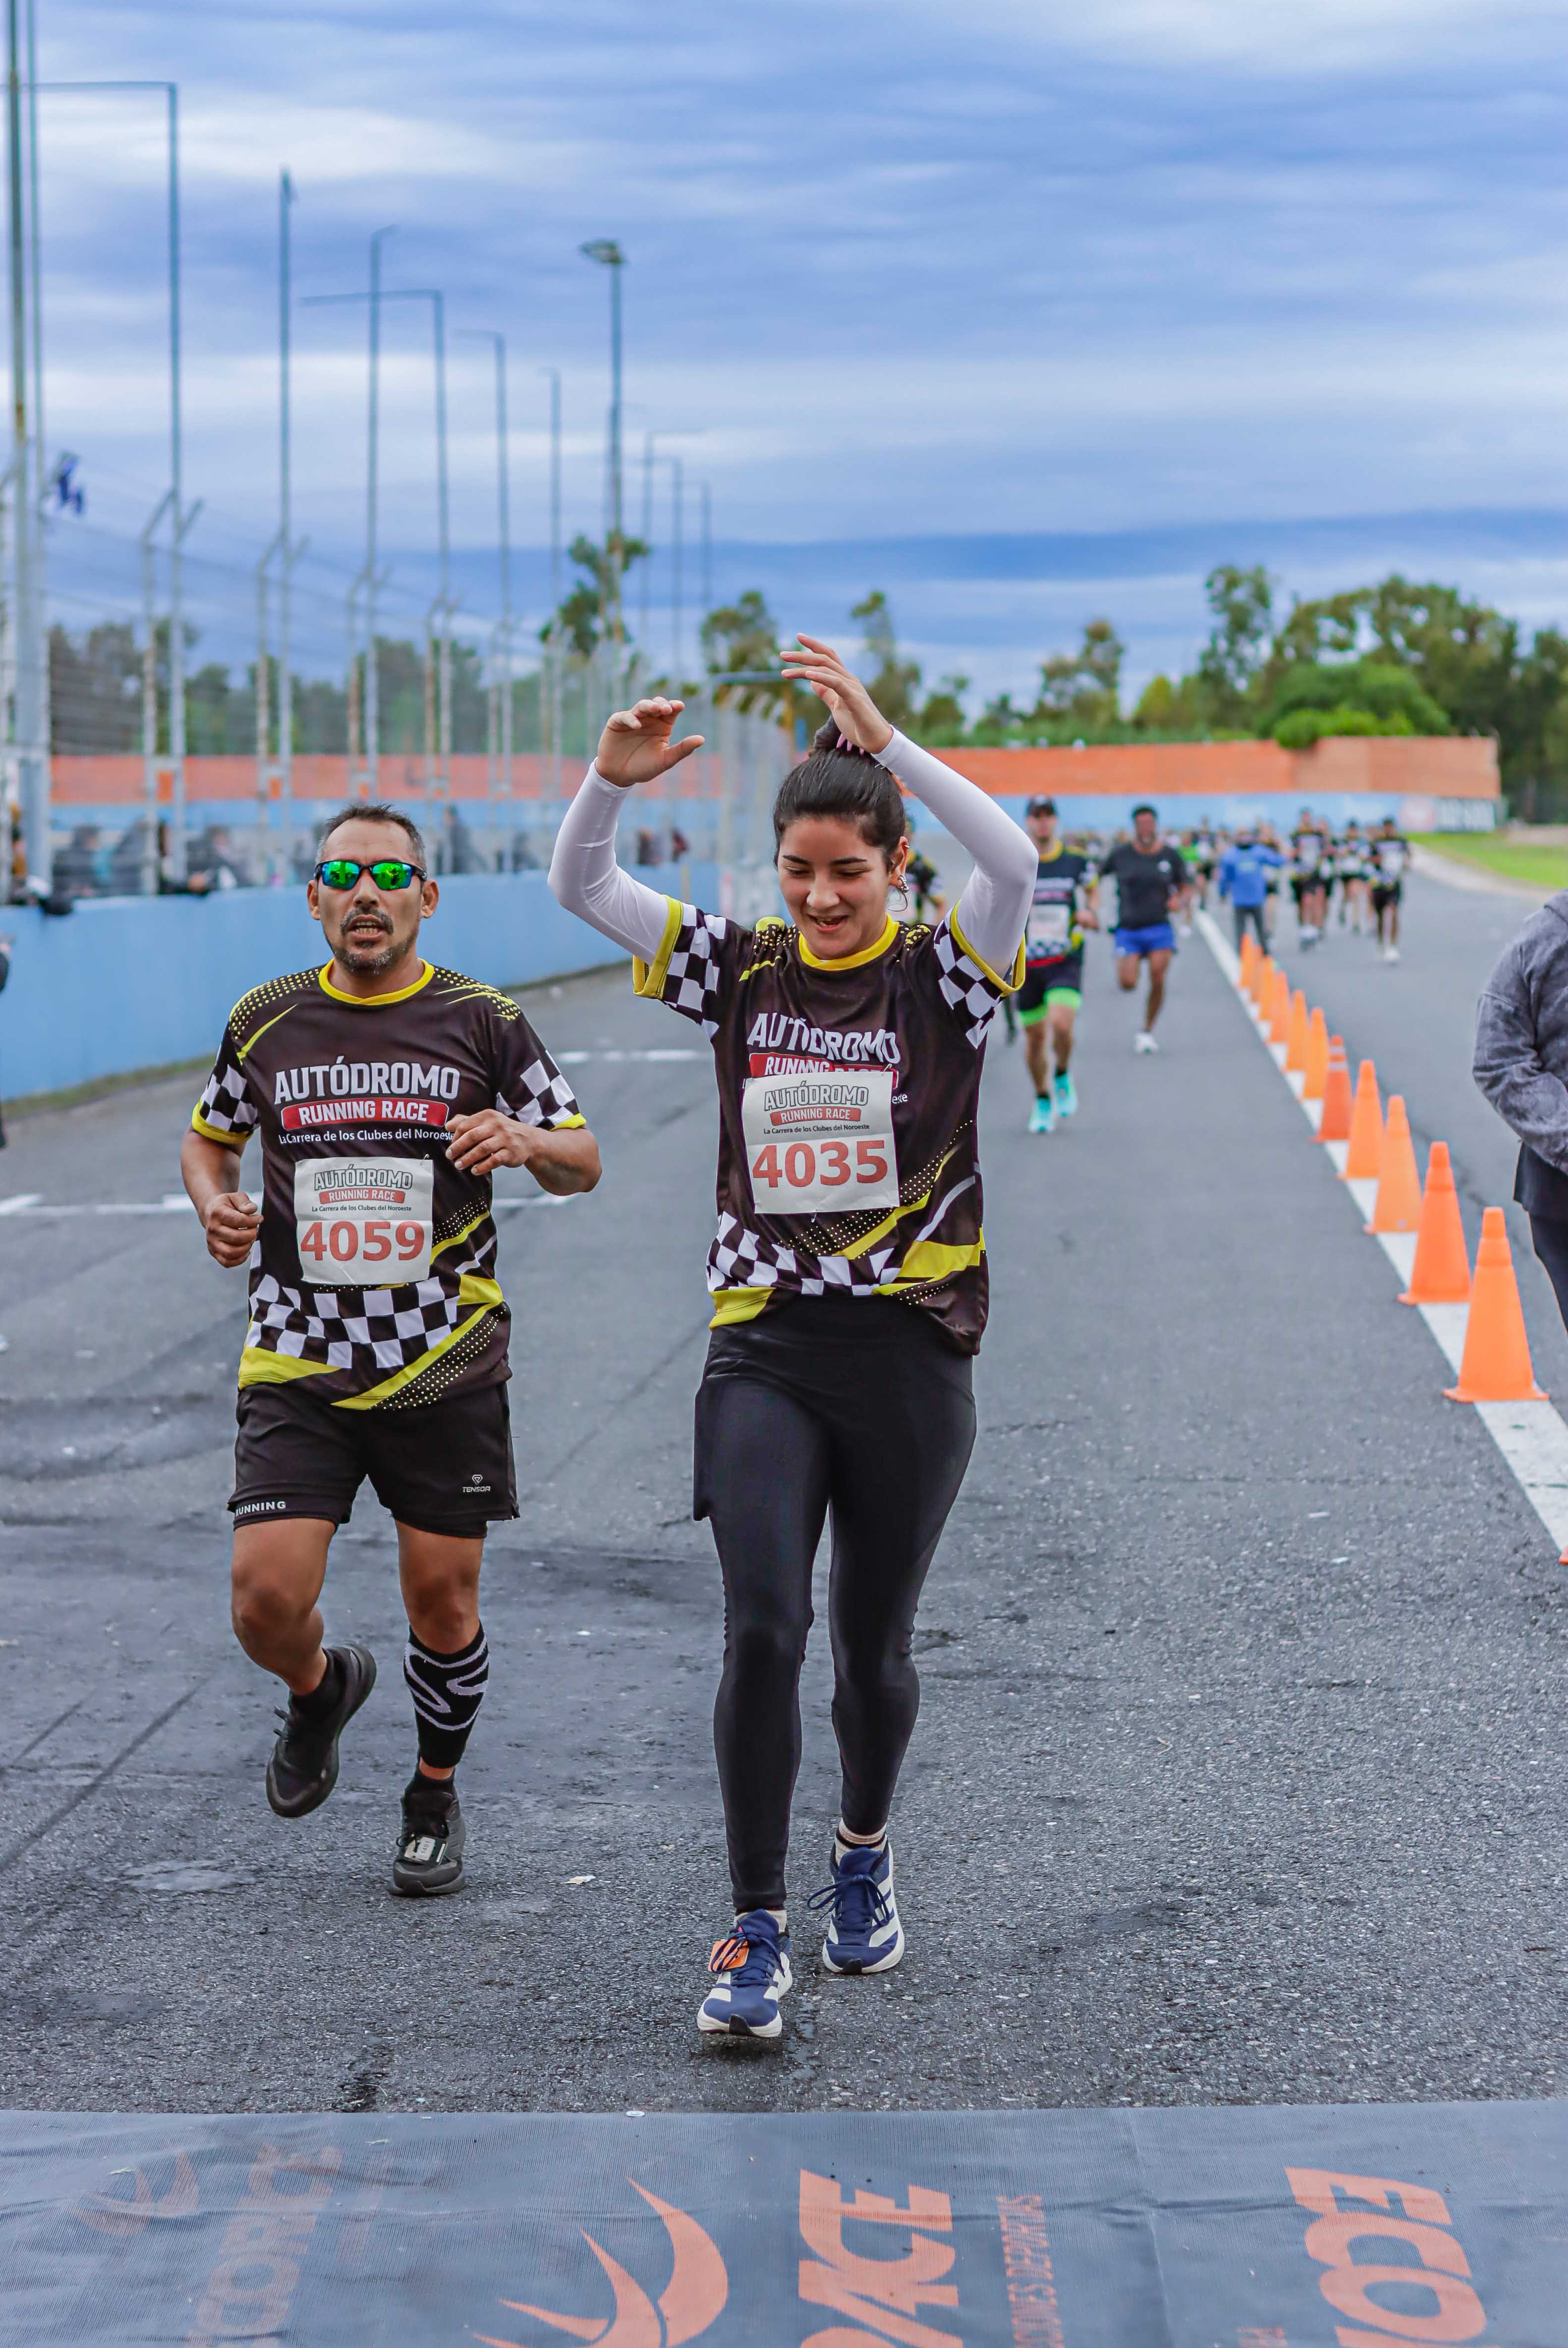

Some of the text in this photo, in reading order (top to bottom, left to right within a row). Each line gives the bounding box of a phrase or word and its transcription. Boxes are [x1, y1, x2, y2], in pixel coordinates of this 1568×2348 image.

[274, 1056, 460, 1105] AUTÓDROMO
[764, 1080, 869, 1111] AUTÓDROMO
[298, 1100, 429, 1125] RUNNING RACE
[781, 1108, 851, 1123] RUNNING RACE
[279, 1134, 286, 1144] La
[286, 1133, 321, 1144] Carrera
[324, 1131, 336, 1141] de
[339, 1130, 354, 1140] los
[357, 1130, 392, 1140] Clubes
[395, 1129, 411, 1139] del
[314, 1164, 412, 1190] AUTÓDROMO
[752, 1140, 888, 1188] 4035
[329, 1189, 395, 1202] RUNNING RACE
[301, 1221, 424, 1261] 4059
[1285, 2167, 1497, 2348] ECO
